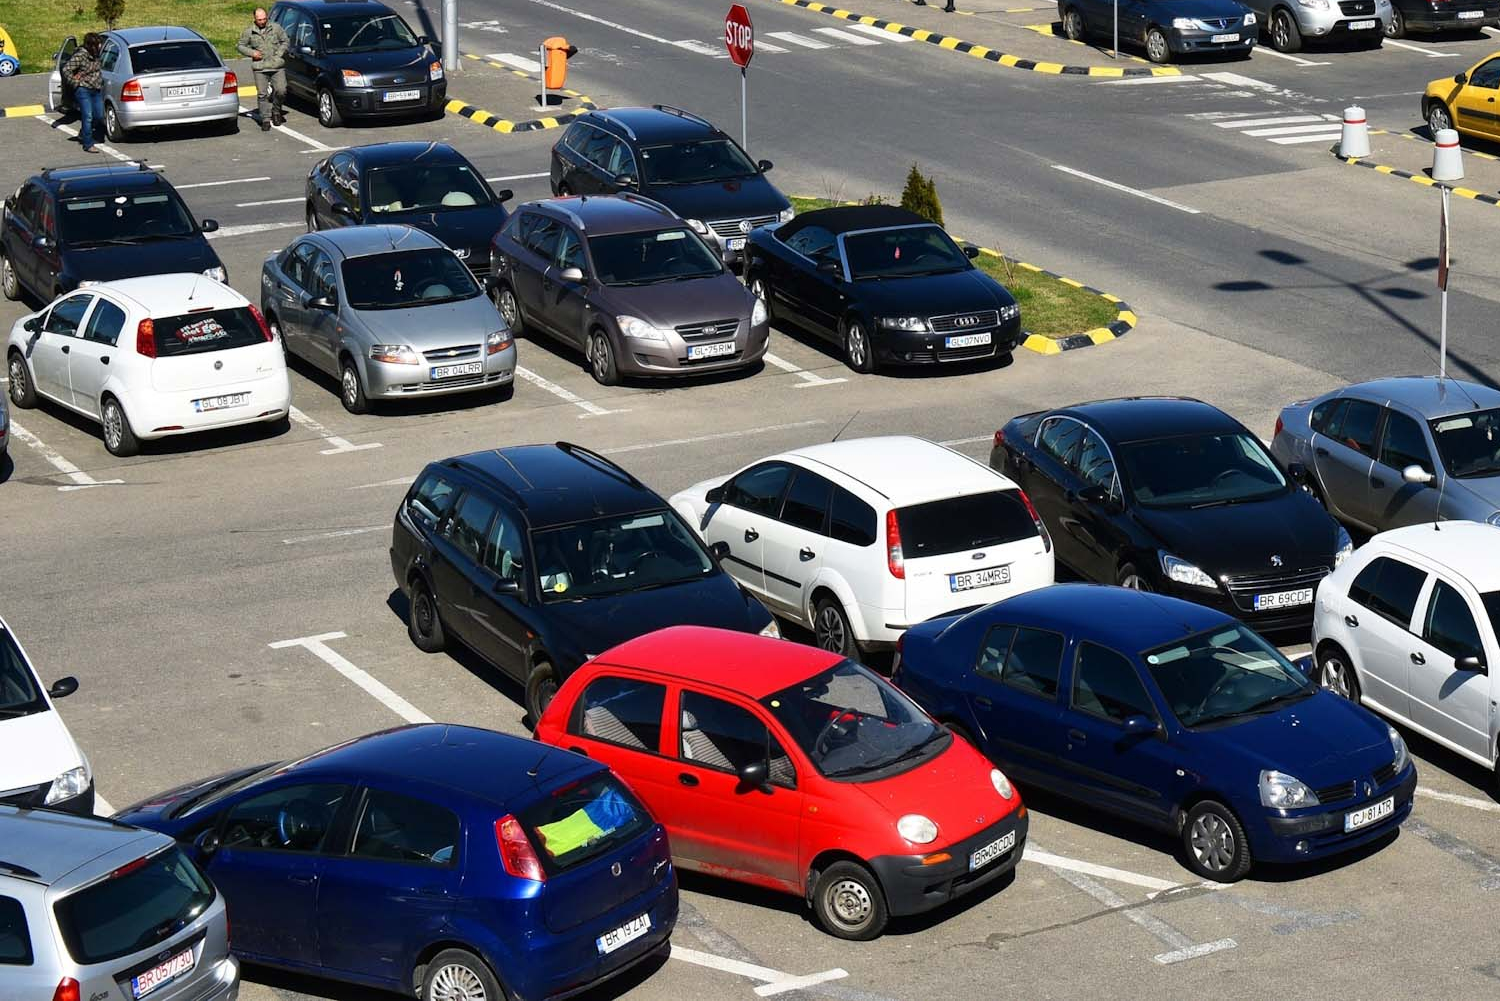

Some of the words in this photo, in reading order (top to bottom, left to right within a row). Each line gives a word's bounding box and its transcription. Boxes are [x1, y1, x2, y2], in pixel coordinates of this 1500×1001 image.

[726, 21, 751, 50] STOP
[951, 338, 961, 346] GL
[694, 348, 705, 356] GL
[437, 368, 449, 377] BR
[956, 574, 971, 587] BR
[1259, 595, 1273, 607] BR
[1352, 813, 1364, 826] CJ
[974, 849, 985, 866] BR
[604, 930, 618, 946] BR
[137, 972, 153, 991] BR
